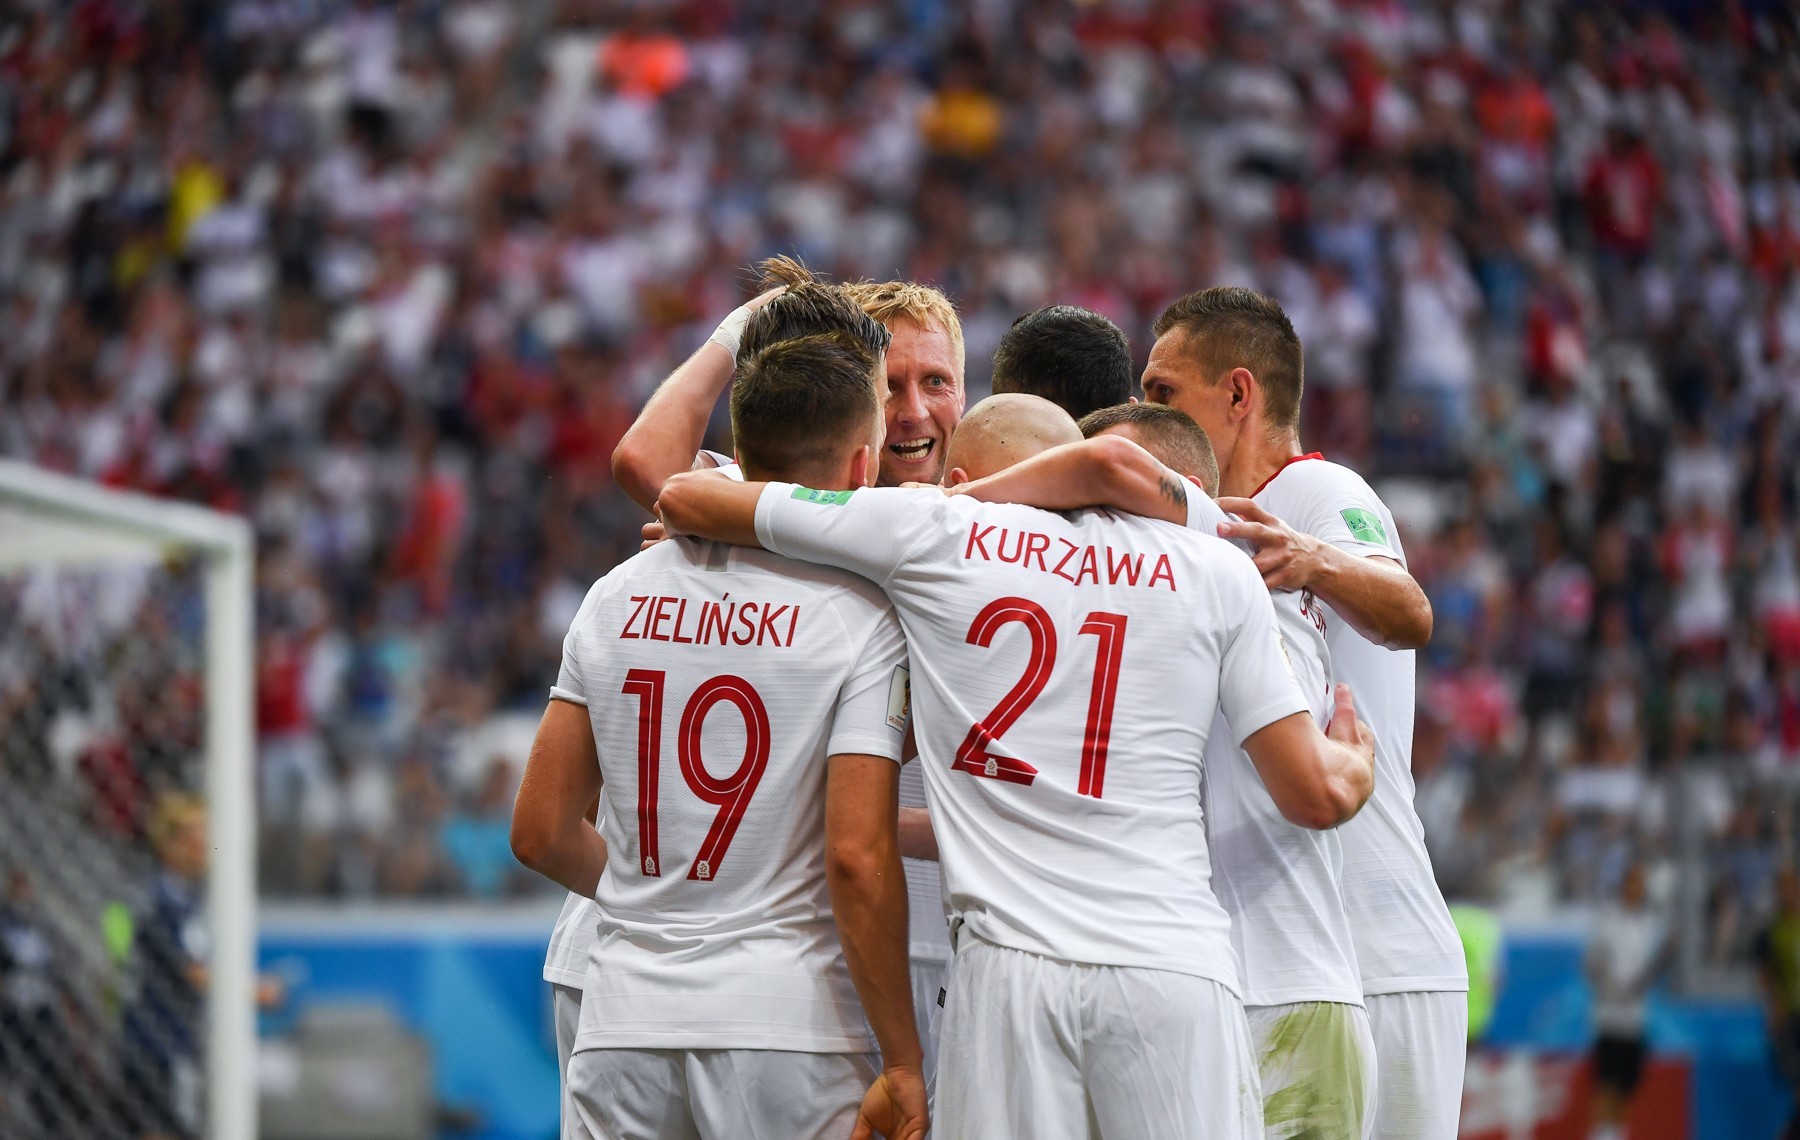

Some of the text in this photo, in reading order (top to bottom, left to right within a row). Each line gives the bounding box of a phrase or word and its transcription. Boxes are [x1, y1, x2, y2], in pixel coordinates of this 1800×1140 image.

[619, 592, 800, 647] ZIELIŃSKI
[965, 522, 1177, 592] KURZAWA
[951, 597, 1128, 799] 21
[621, 669, 771, 882] 19
